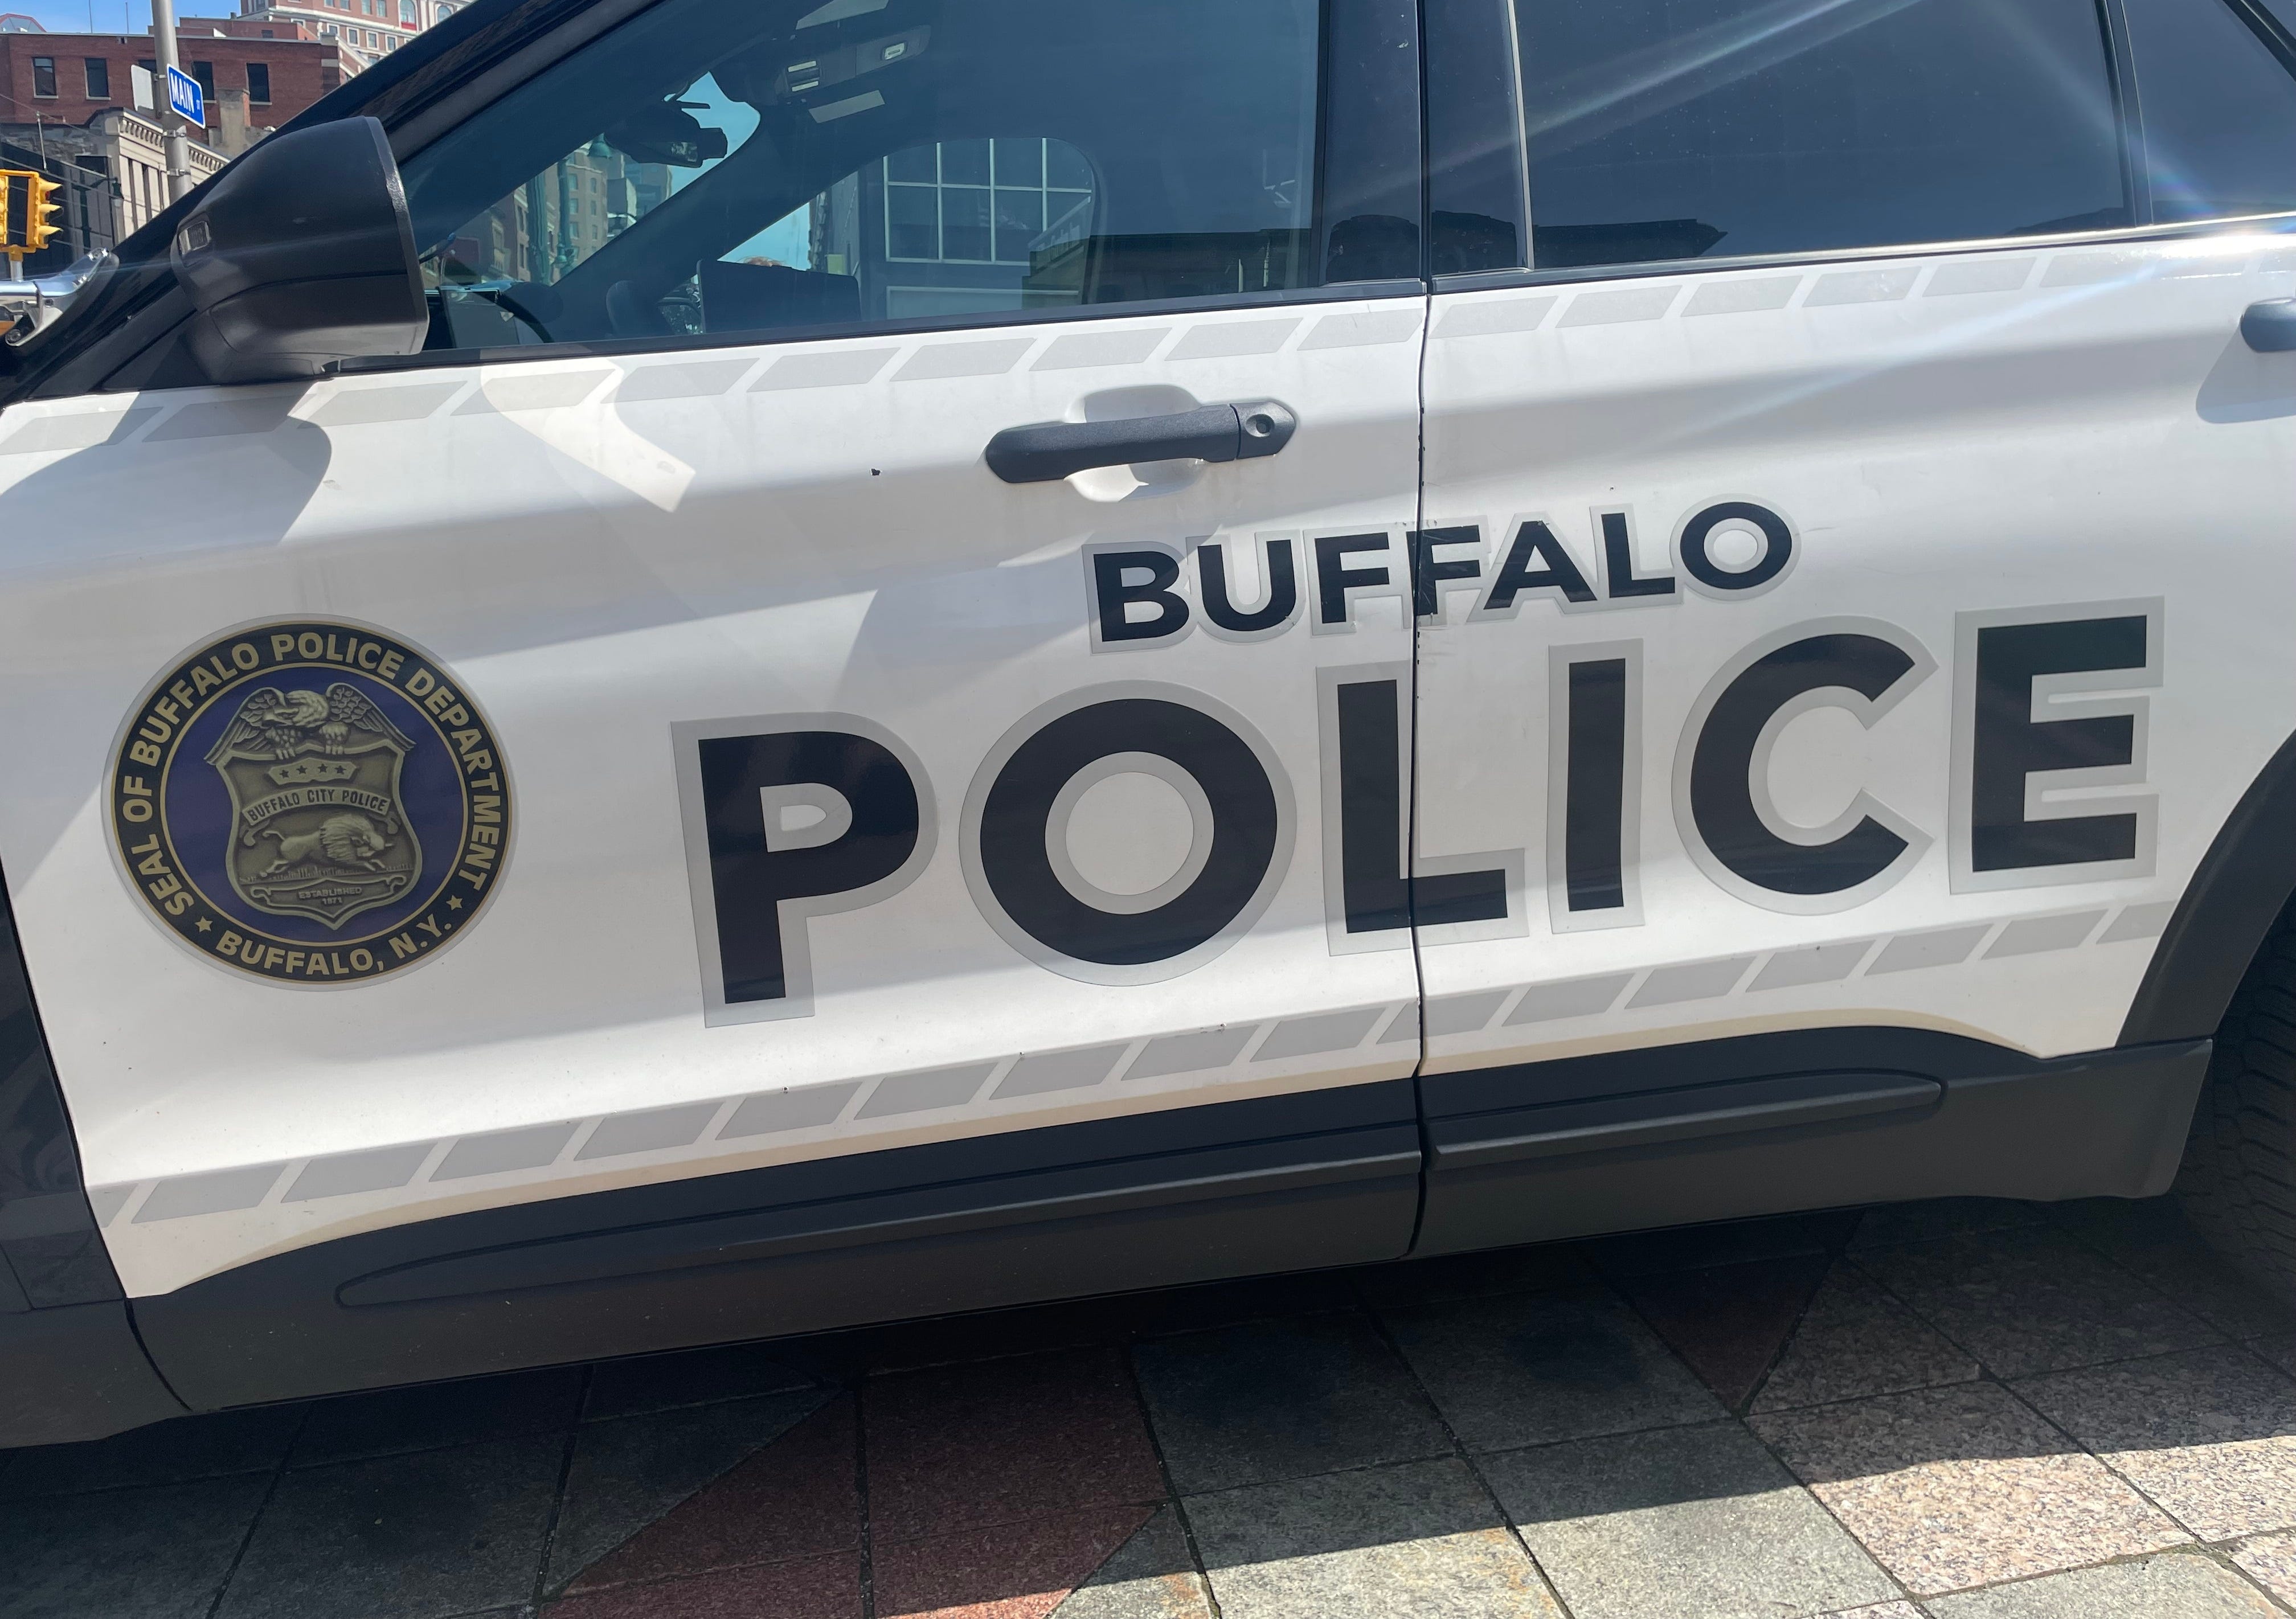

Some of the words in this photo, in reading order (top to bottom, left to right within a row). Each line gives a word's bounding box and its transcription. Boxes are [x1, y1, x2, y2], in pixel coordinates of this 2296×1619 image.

[170, 73, 194, 113] MAIN
[1093, 502, 1792, 641] BUFFALO
[269, 632, 405, 680] POLICE
[130, 642, 259, 767] BUFFALO
[122, 775, 153, 822] OF
[247, 793, 300, 821] BUFFALO
[307, 789, 335, 803] CITY
[342, 789, 388, 812] POLICE
[404, 667, 502, 891] DEPARTMENT
[698, 615, 2147, 1005] POLICE
[132, 833, 194, 916] SEAL
[298, 887, 362, 899] ESTABLISHED
[215, 929, 384, 976] BUFFALO,
[388, 915, 452, 958] N.Y.
